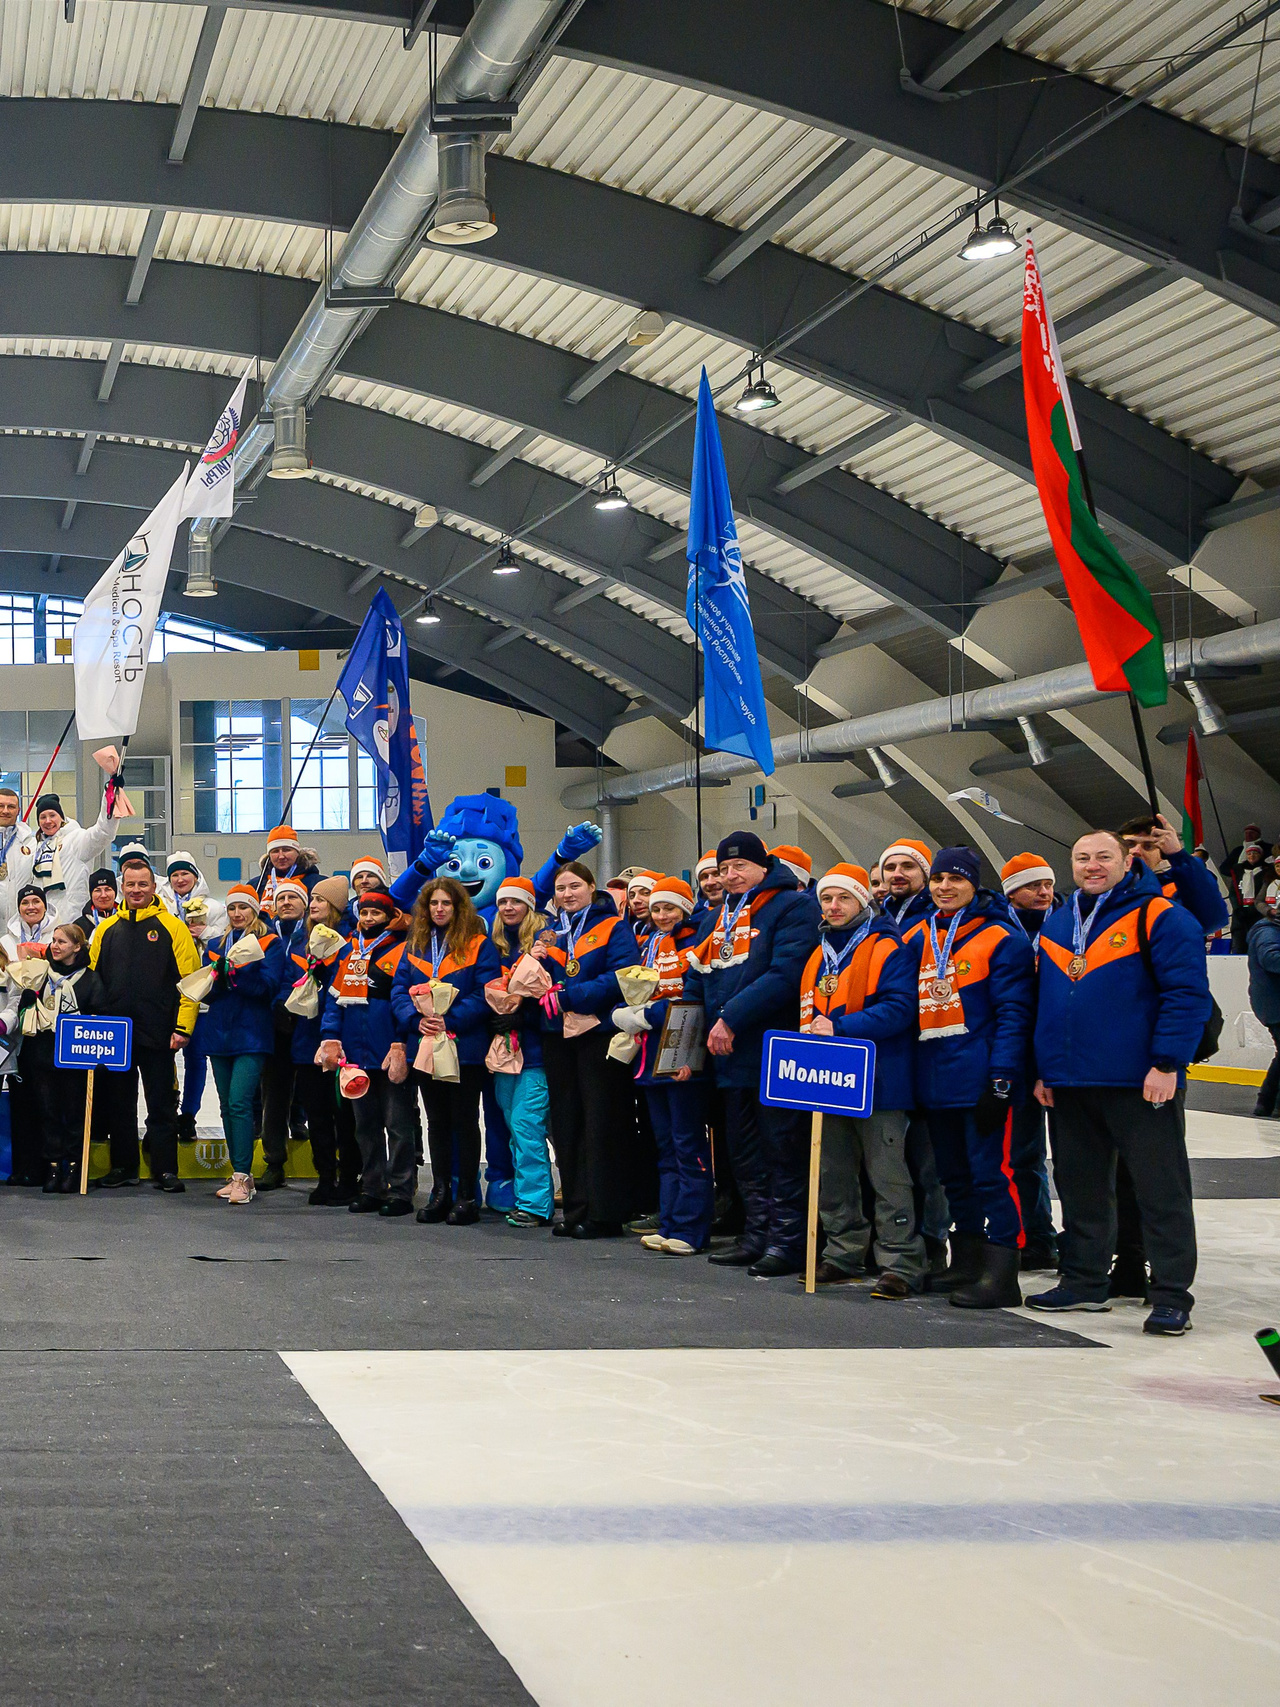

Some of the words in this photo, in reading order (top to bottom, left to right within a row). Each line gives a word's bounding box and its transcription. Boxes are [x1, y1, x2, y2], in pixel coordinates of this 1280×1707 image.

[111, 577, 121, 615] Medical
[112, 652, 122, 684] Resort
[74, 1025, 114, 1041] Белые
[71, 1044, 115, 1059] тигры
[778, 1059, 856, 1089] Молния
